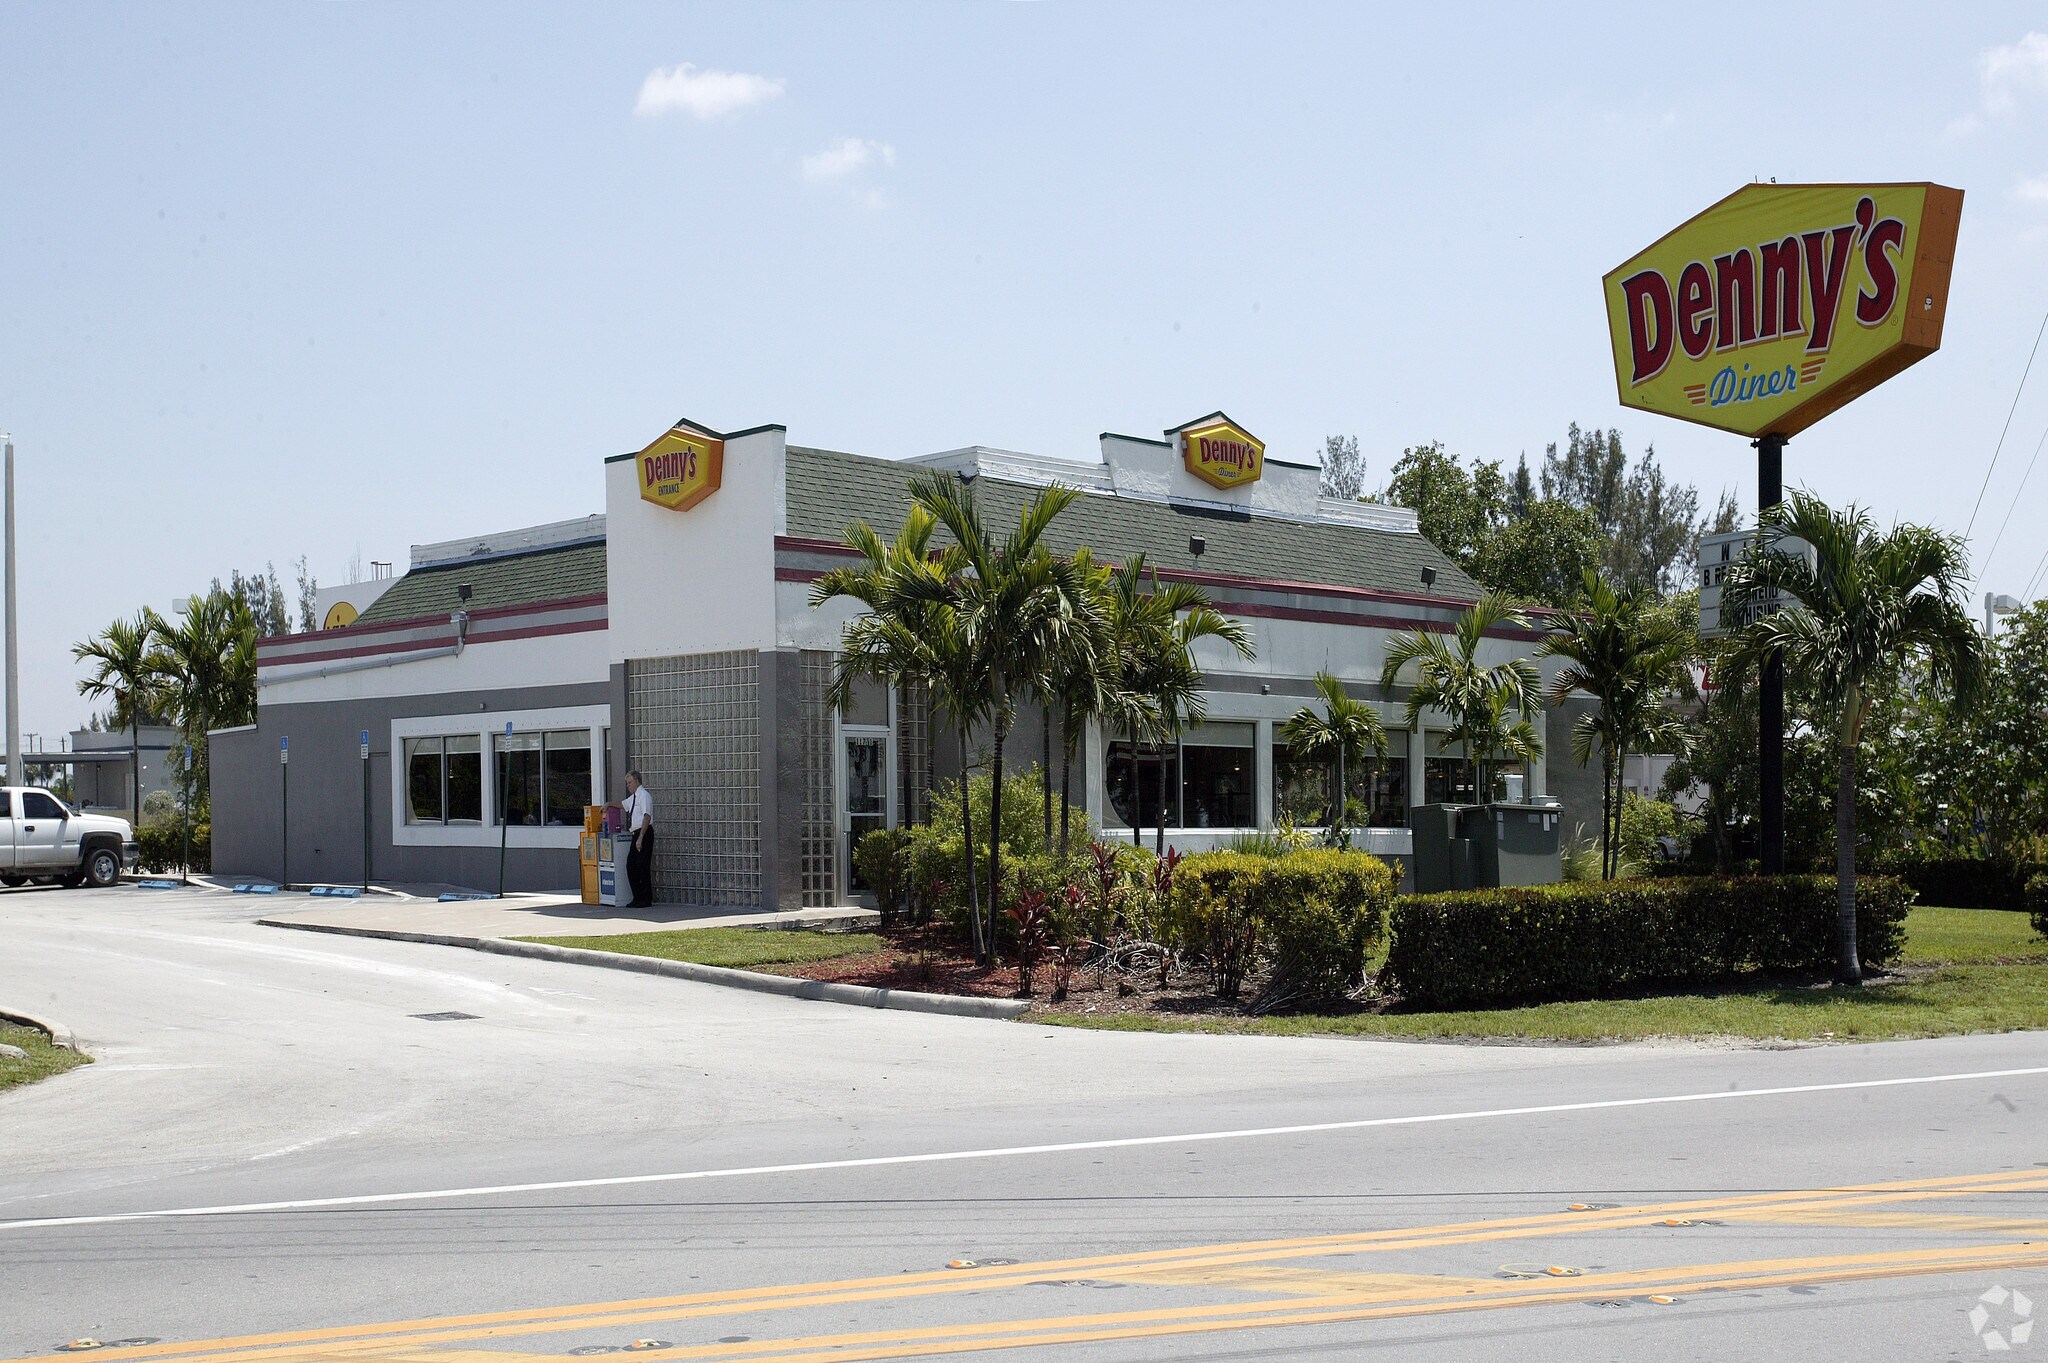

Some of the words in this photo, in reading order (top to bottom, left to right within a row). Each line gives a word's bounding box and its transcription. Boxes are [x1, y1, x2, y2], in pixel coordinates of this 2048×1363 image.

[1620, 195, 1904, 385] Denny's
[1710, 363, 1798, 406] Diner
[644, 446, 697, 488] Denny's
[1199, 437, 1255, 470] Denny's
[658, 483, 680, 496] ENTRANCE
